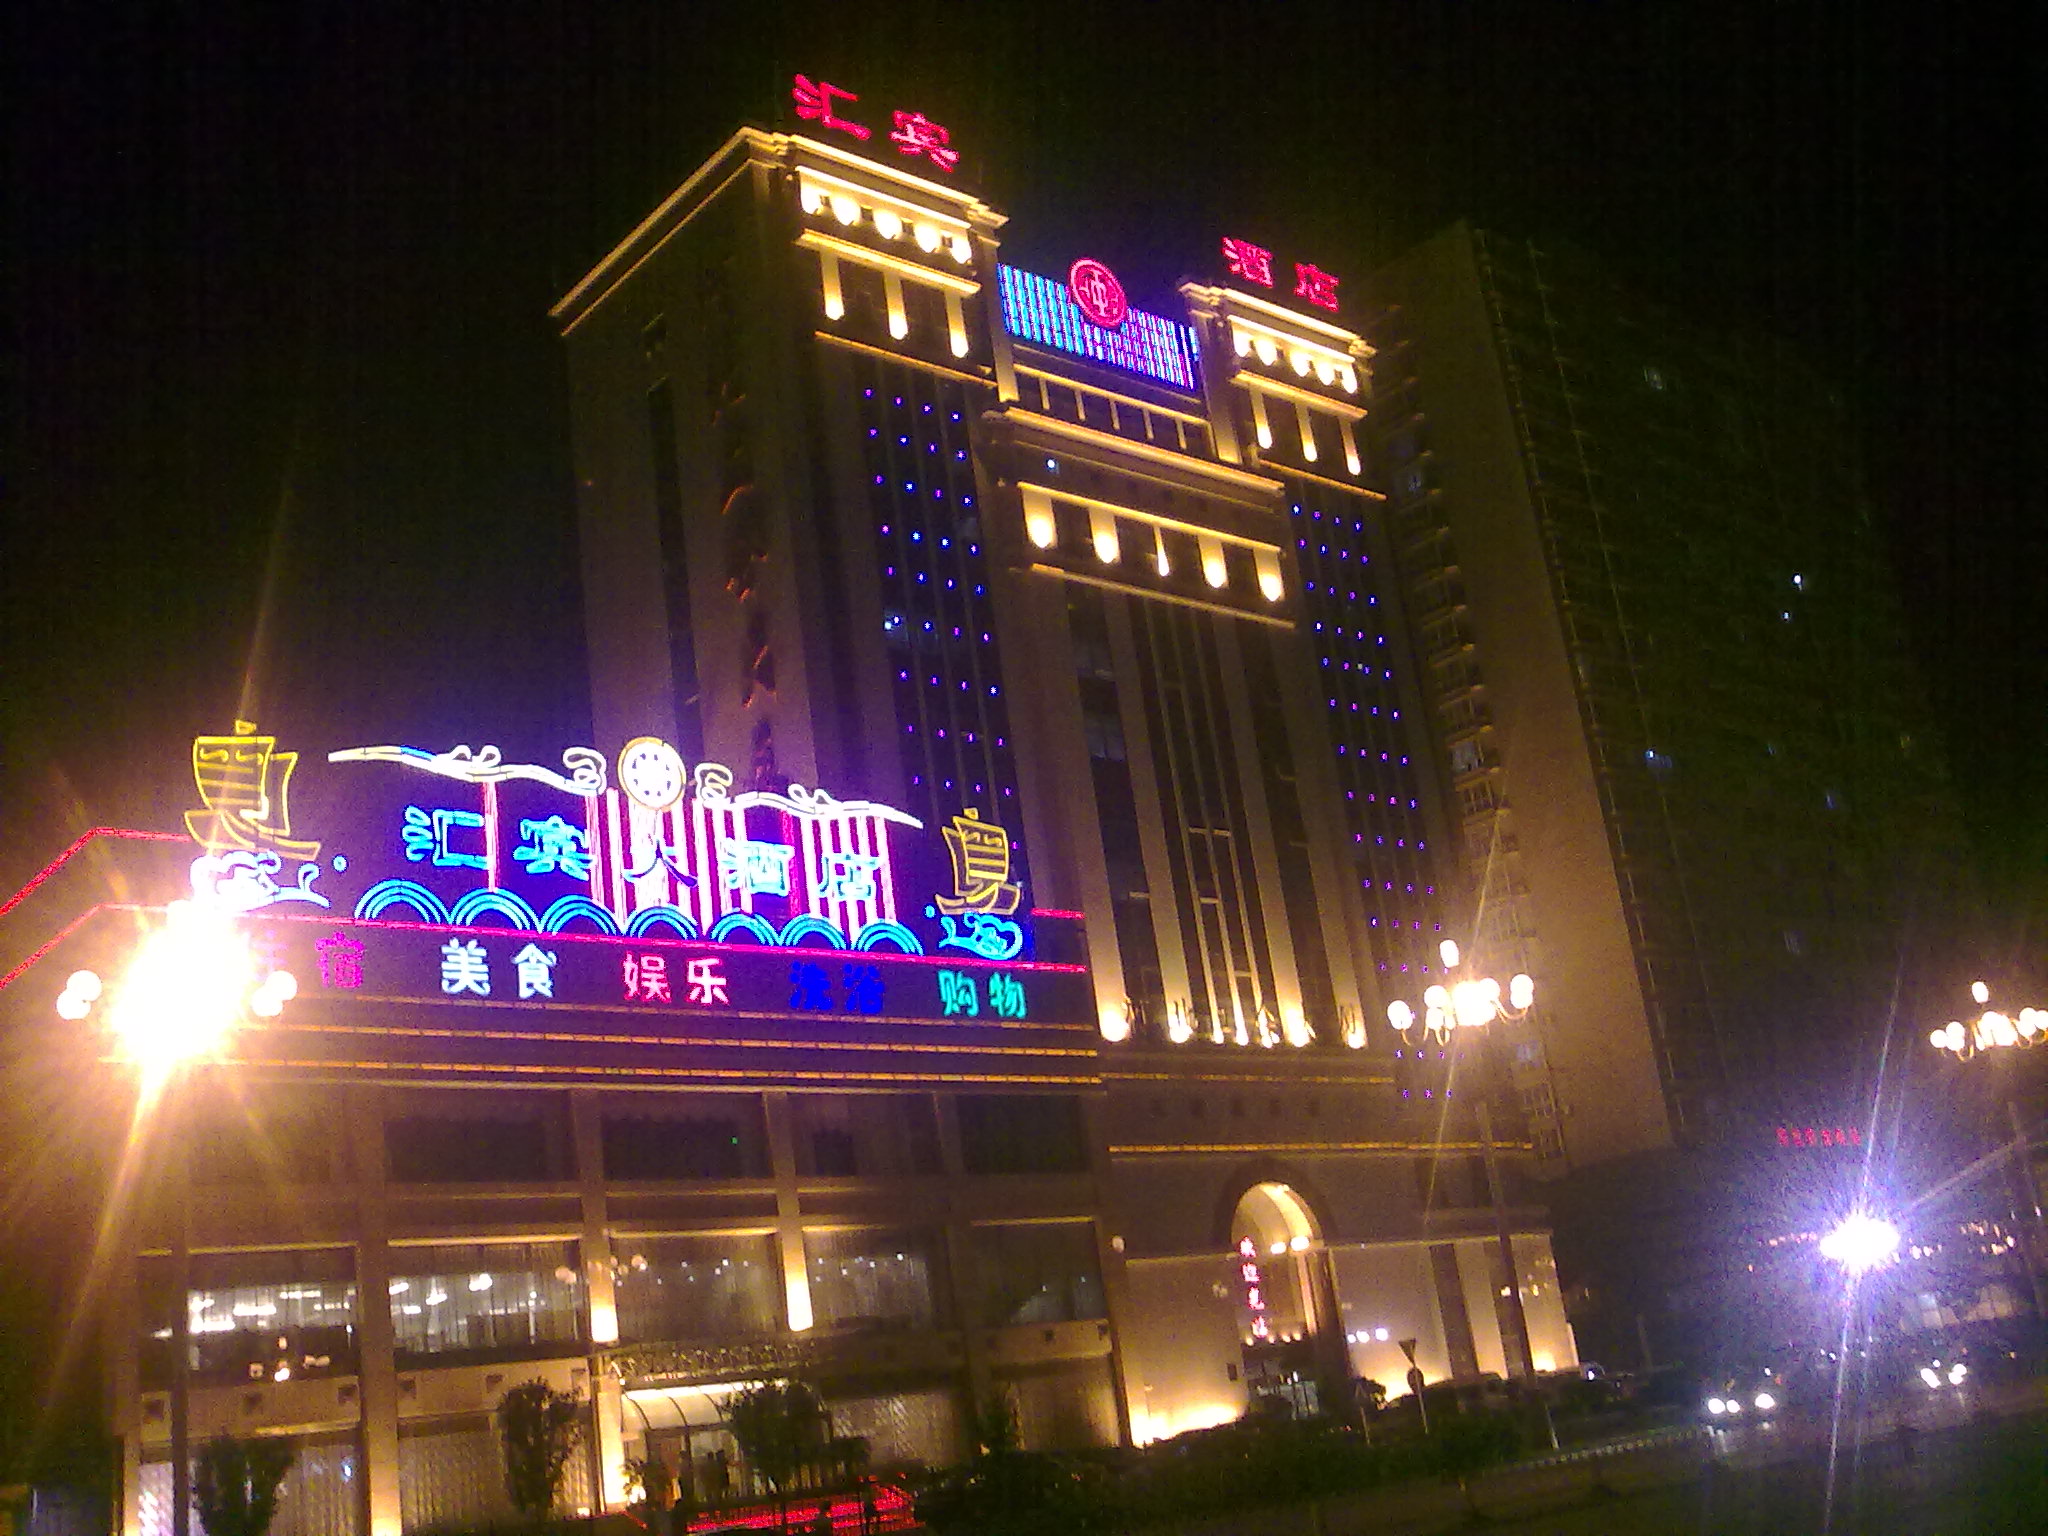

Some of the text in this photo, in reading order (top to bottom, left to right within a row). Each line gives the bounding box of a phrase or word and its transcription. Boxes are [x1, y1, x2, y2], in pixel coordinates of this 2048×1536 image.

[792, 74, 1340, 311] 汇宾 酒店
[440, 936, 558, 1000] 美食
[622, 950, 731, 1006] 娱乐
[788, 961, 886, 1015] 洗浴
[938, 968, 1028, 1019] 购物
